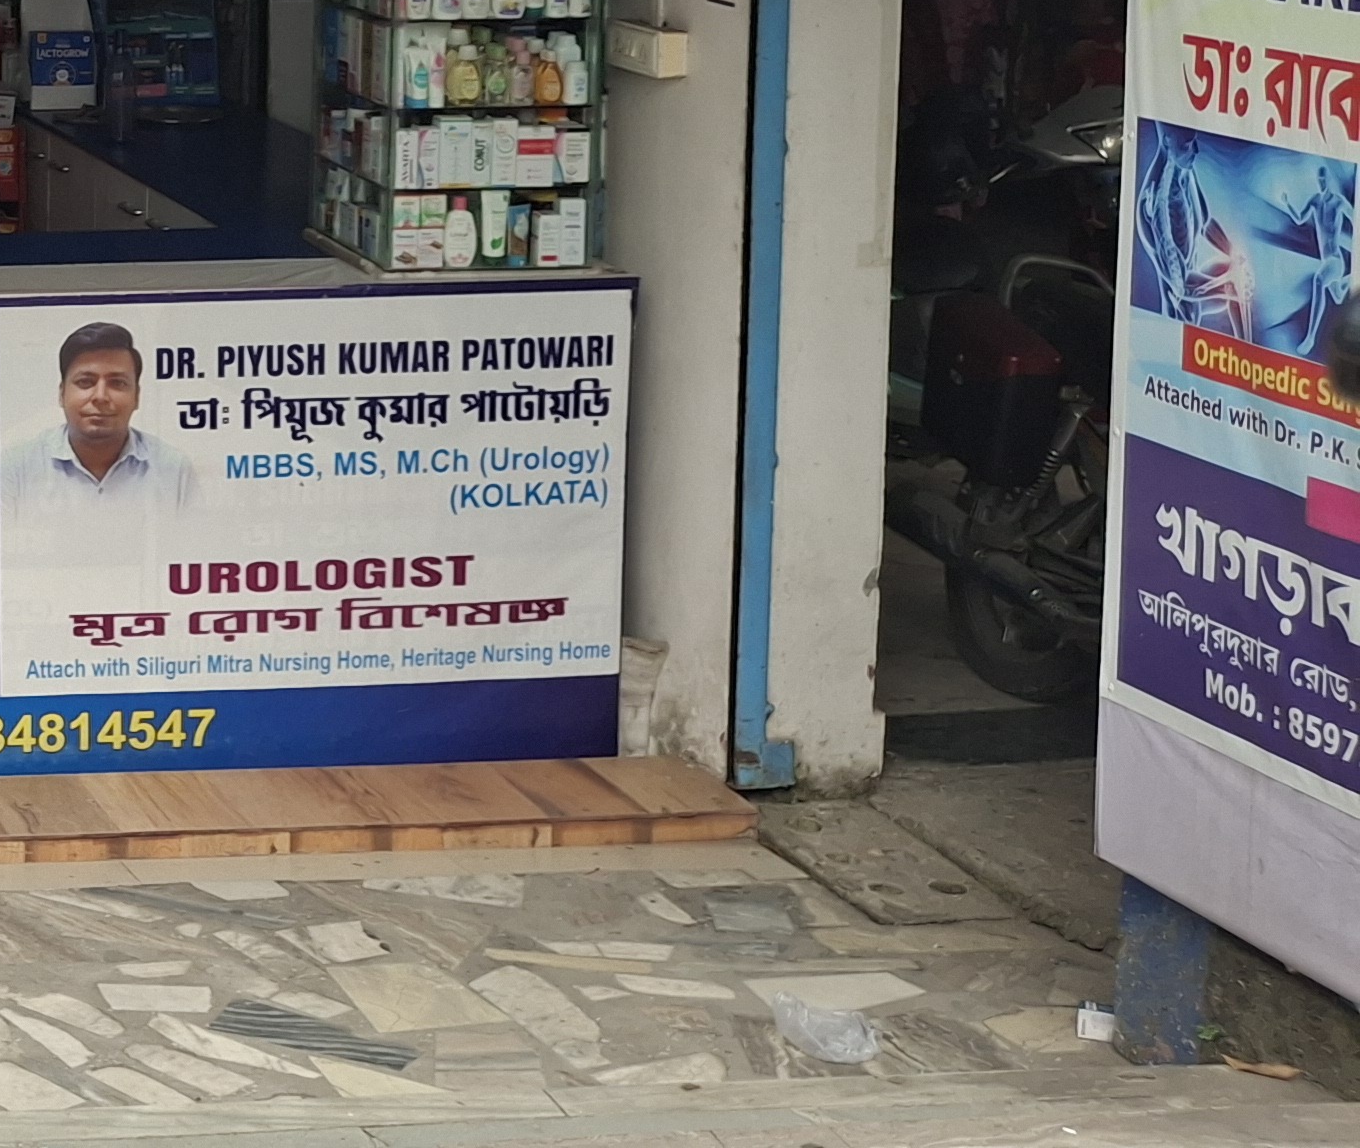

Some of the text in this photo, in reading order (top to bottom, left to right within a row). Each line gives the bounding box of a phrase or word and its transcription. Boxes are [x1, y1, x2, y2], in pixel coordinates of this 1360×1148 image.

[155, 334, 615, 381] DR. PIYUSH KUMAR PATOWARI
[1193, 338, 1311, 401] Orthopedic
[355, 392, 450, 442] কুমার
[1144, 375, 1351, 466] Attached with Dr. P.K.
[225, 442, 611, 483] MBBS, MS, M.Ch (Urology)
[449, 480, 609, 514] (KOLKATA)
[168, 554, 476, 596] UROLOGIST
[187, 596, 569, 642] রোগ বিশেষজ্ঞ
[26, 640, 611, 680] Attach with Siliguri Mitra Nursing Home, Heritage Nursing Home
[1204, 667, 1264, 723] Mob.
